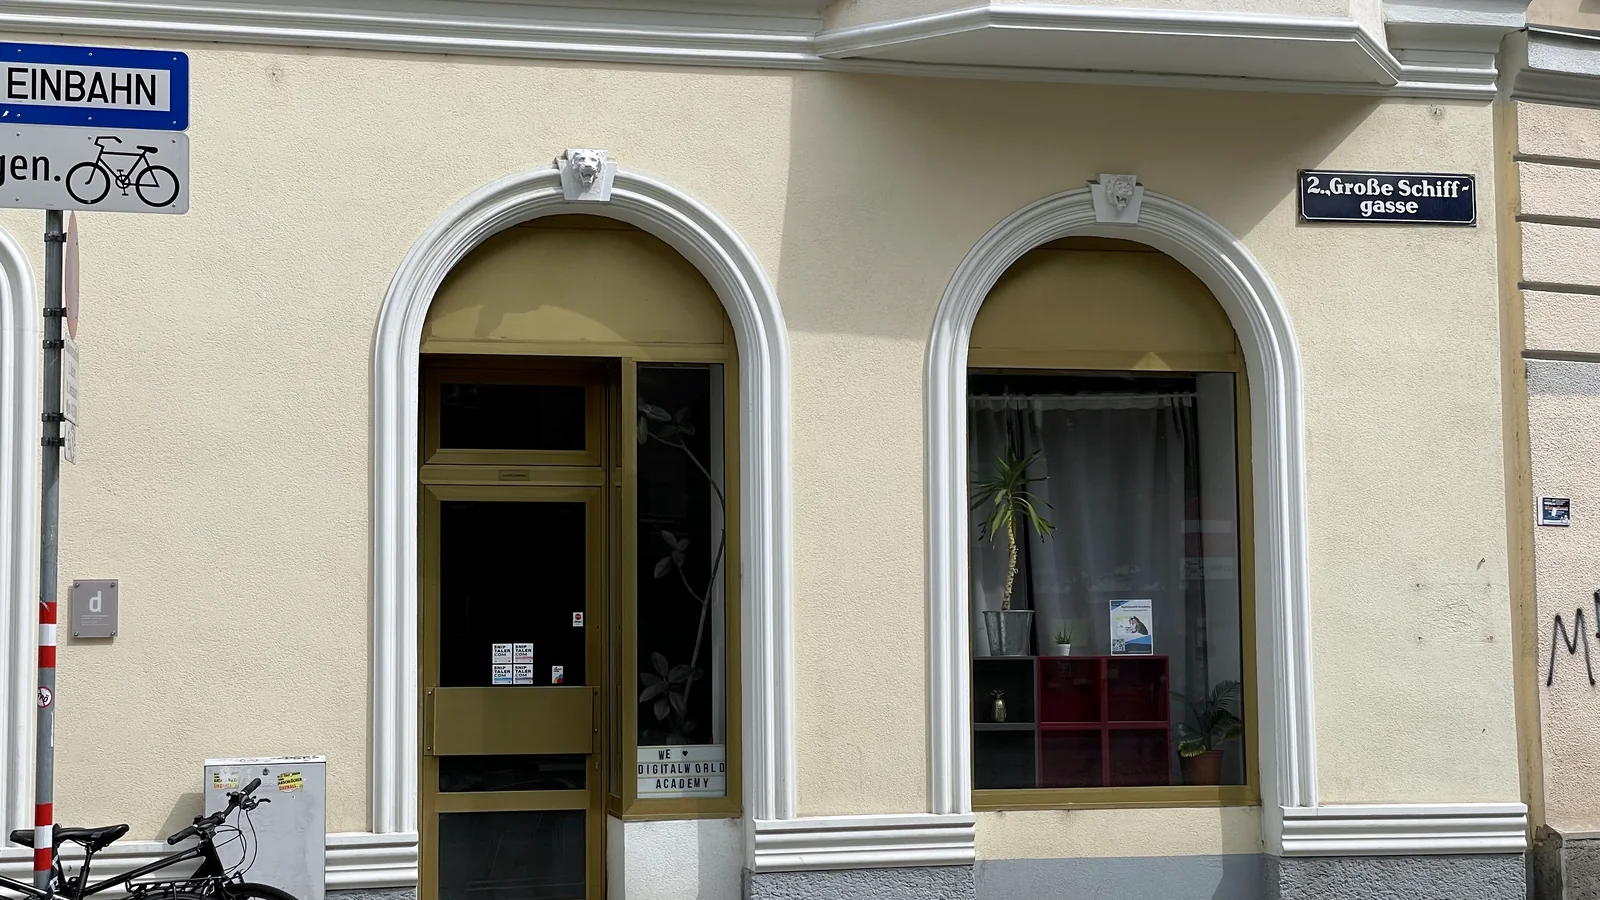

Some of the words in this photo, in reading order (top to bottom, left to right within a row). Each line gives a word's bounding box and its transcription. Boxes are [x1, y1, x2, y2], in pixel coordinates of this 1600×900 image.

[7, 67, 156, 106] EINBAHN
[1360, 199, 1419, 217] gasse
[658, 749, 671, 761] WE
[655, 778, 709, 789] ACADEMY
